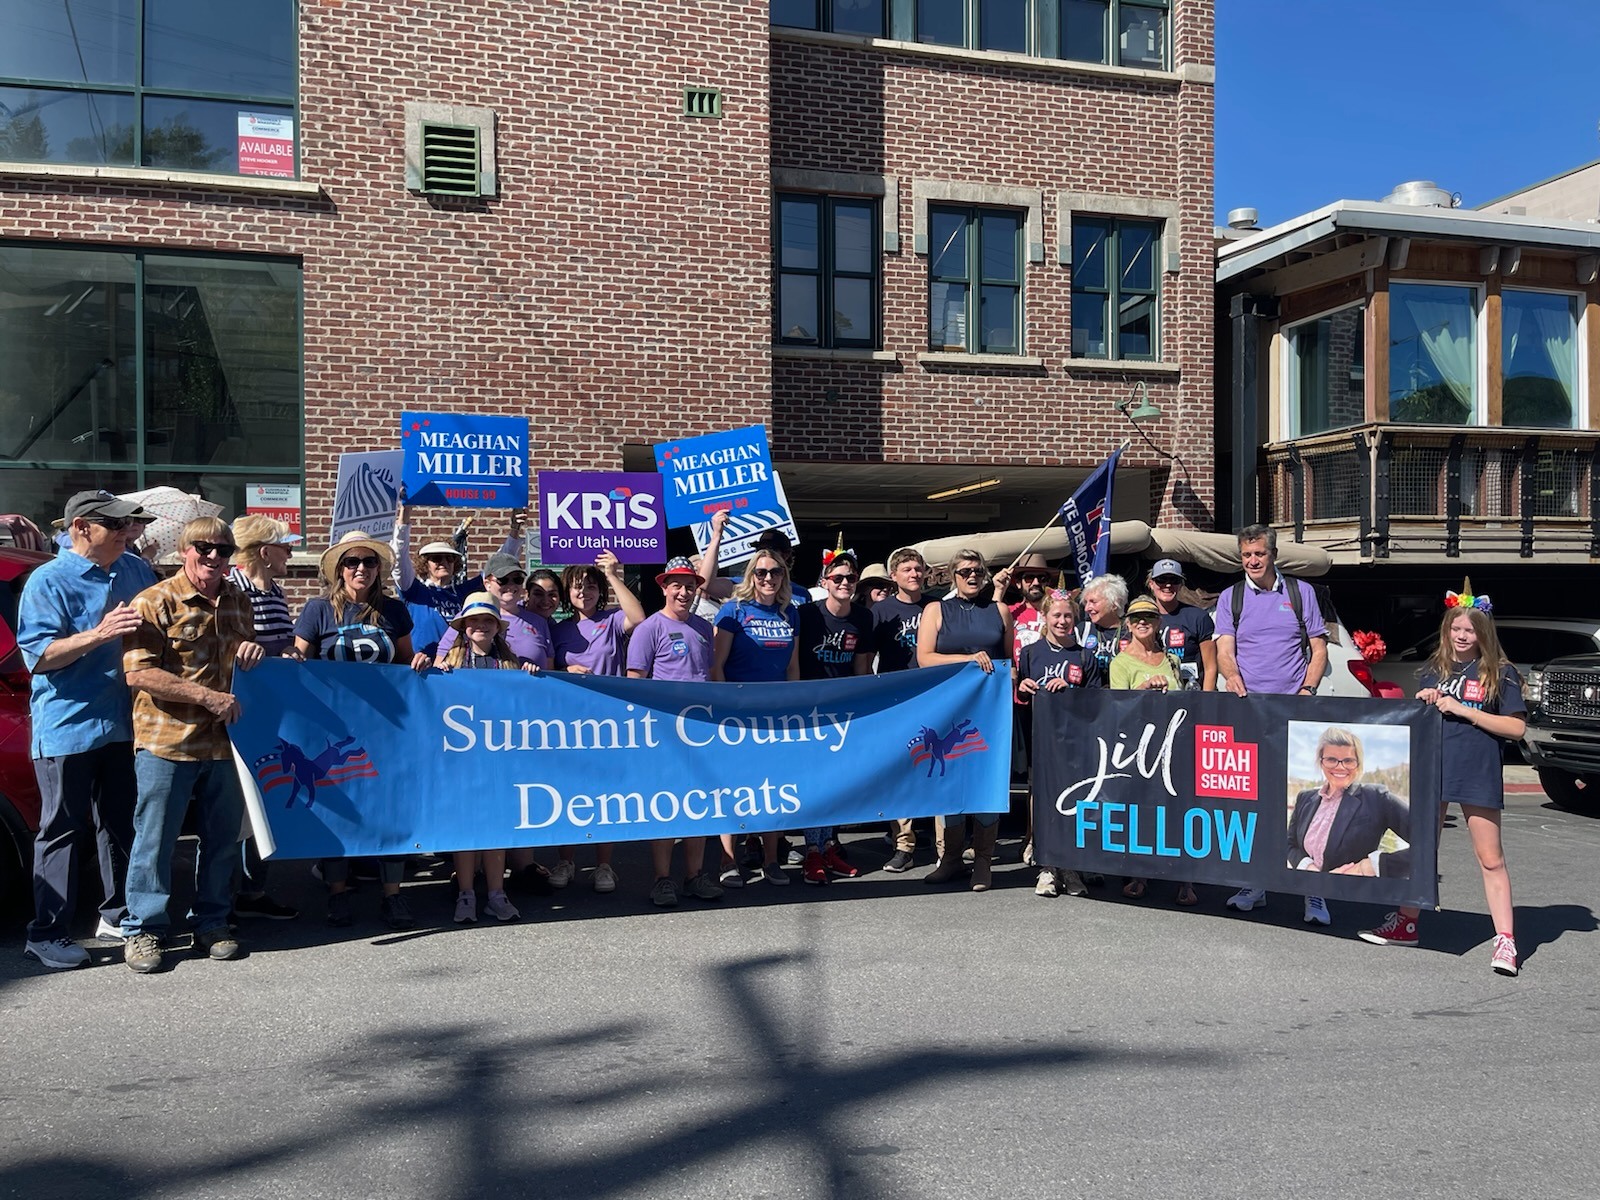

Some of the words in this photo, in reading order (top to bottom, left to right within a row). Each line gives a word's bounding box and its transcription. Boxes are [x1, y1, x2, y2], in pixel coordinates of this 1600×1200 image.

[240, 142, 293, 156] AVAILABLE
[420, 432, 520, 450] MEAGHAN
[417, 452, 522, 477] MILLER
[672, 443, 761, 472] MEAGHAN
[673, 462, 768, 497] MILLER
[446, 488, 479, 499] HOUSE
[550, 536, 573, 548] For
[577, 536, 610, 549] Utah
[614, 536, 658, 549] House
[1071, 521, 1094, 588] DEMOCR
[818, 650, 854, 663] FELLOW
[443, 702, 658, 753] Summit
[676, 703, 854, 753] County
[1202, 730, 1227, 744] FOR
[1201, 746, 1251, 773] UTAH
[1200, 774, 1250, 792] SENATE
[514, 777, 802, 830] Democrats
[1076, 800, 1258, 864] FELLOW
